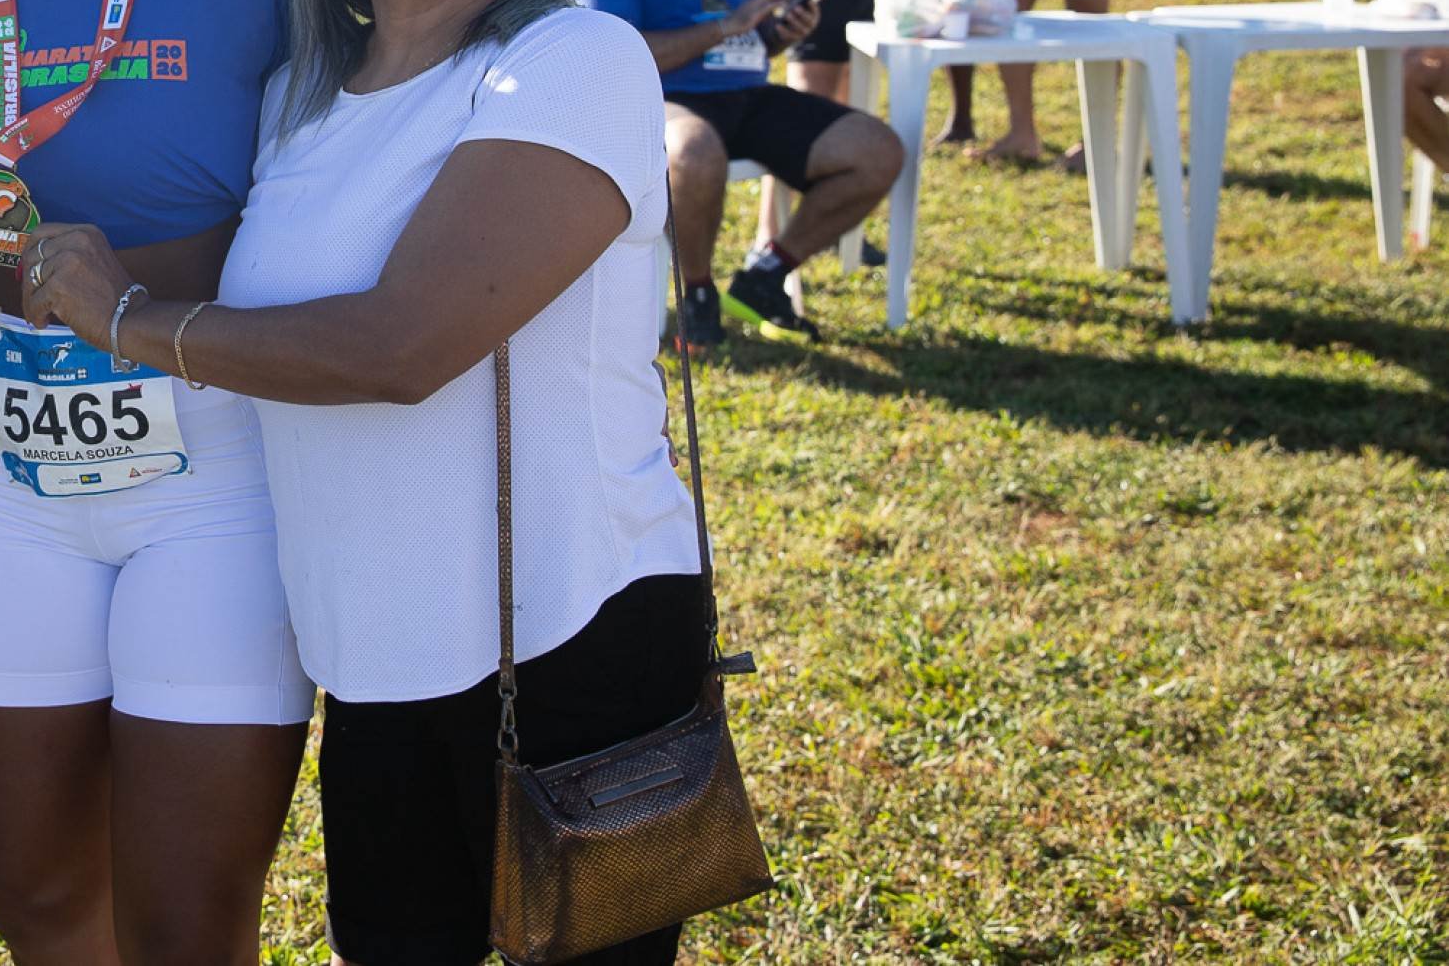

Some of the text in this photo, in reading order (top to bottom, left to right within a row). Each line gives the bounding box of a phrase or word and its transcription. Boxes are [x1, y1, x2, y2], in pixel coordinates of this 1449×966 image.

[3, 387, 150, 446] 5465
[23, 445, 134, 461] MARCELA SOUZA
